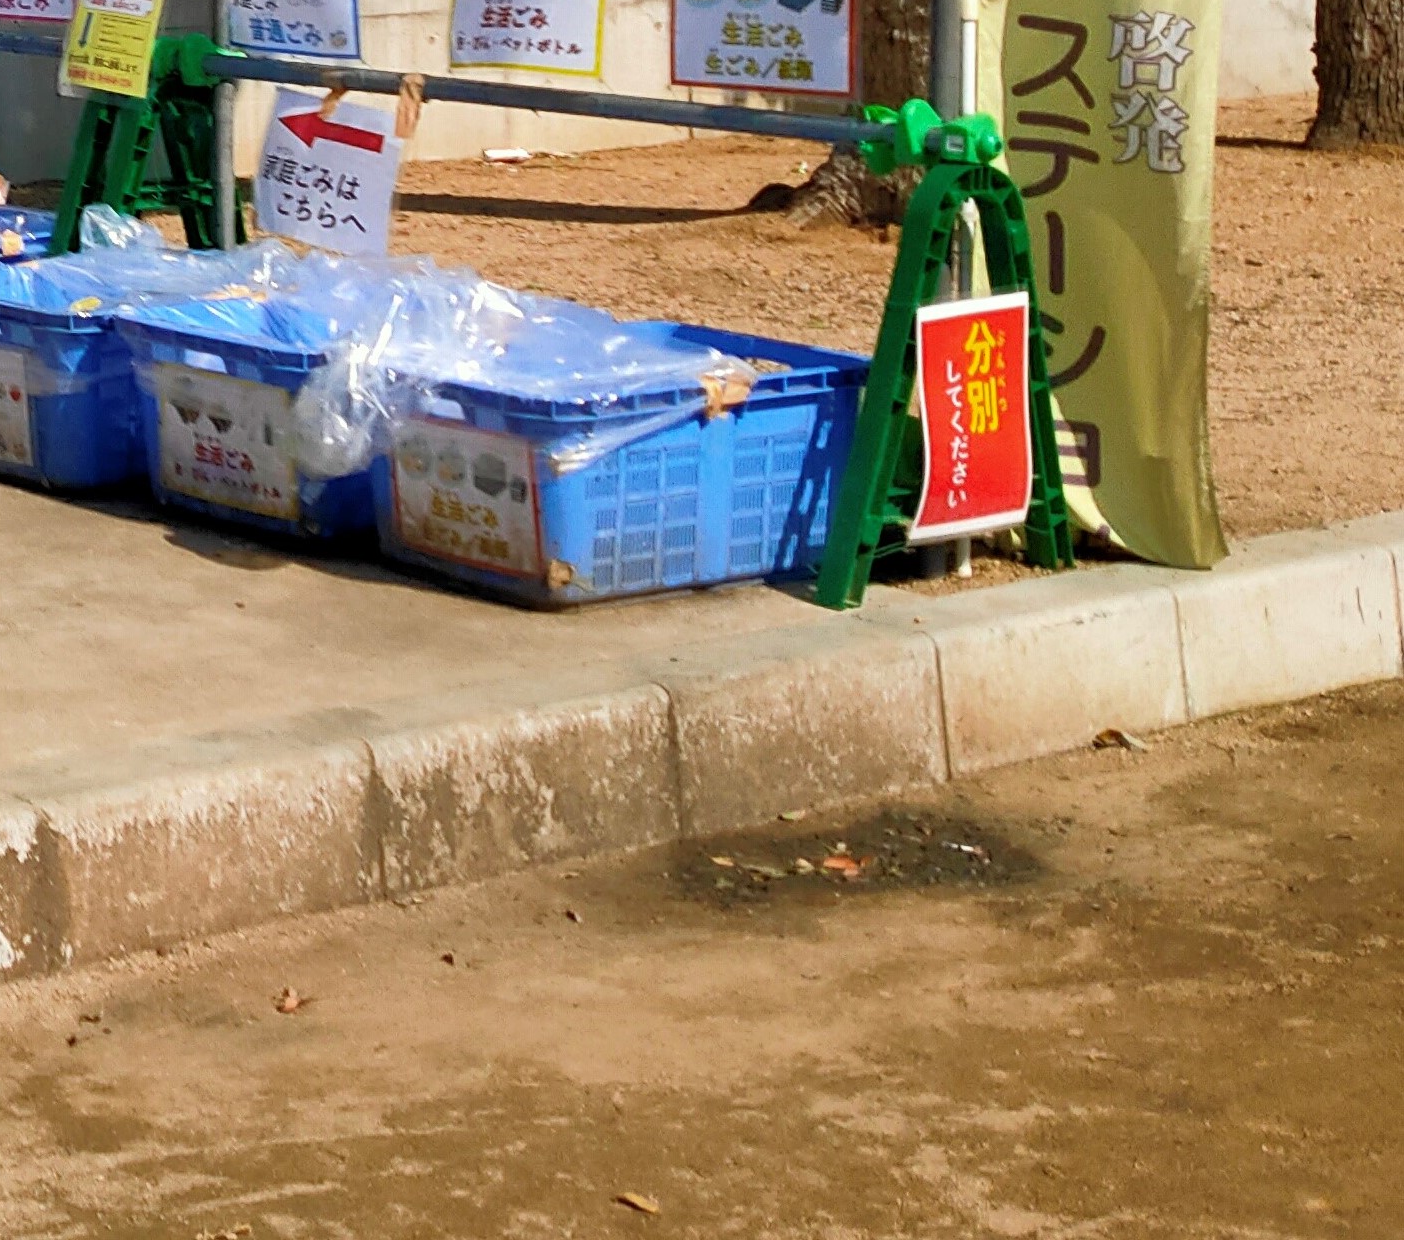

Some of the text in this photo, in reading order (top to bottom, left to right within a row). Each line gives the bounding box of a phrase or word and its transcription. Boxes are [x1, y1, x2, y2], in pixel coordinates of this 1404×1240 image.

[276, 192, 367, 234] こちらへ
[1007, 13, 1106, 540] ステーショ
[944, 359, 969, 510] してください
[964, 319, 999, 434] 分別
